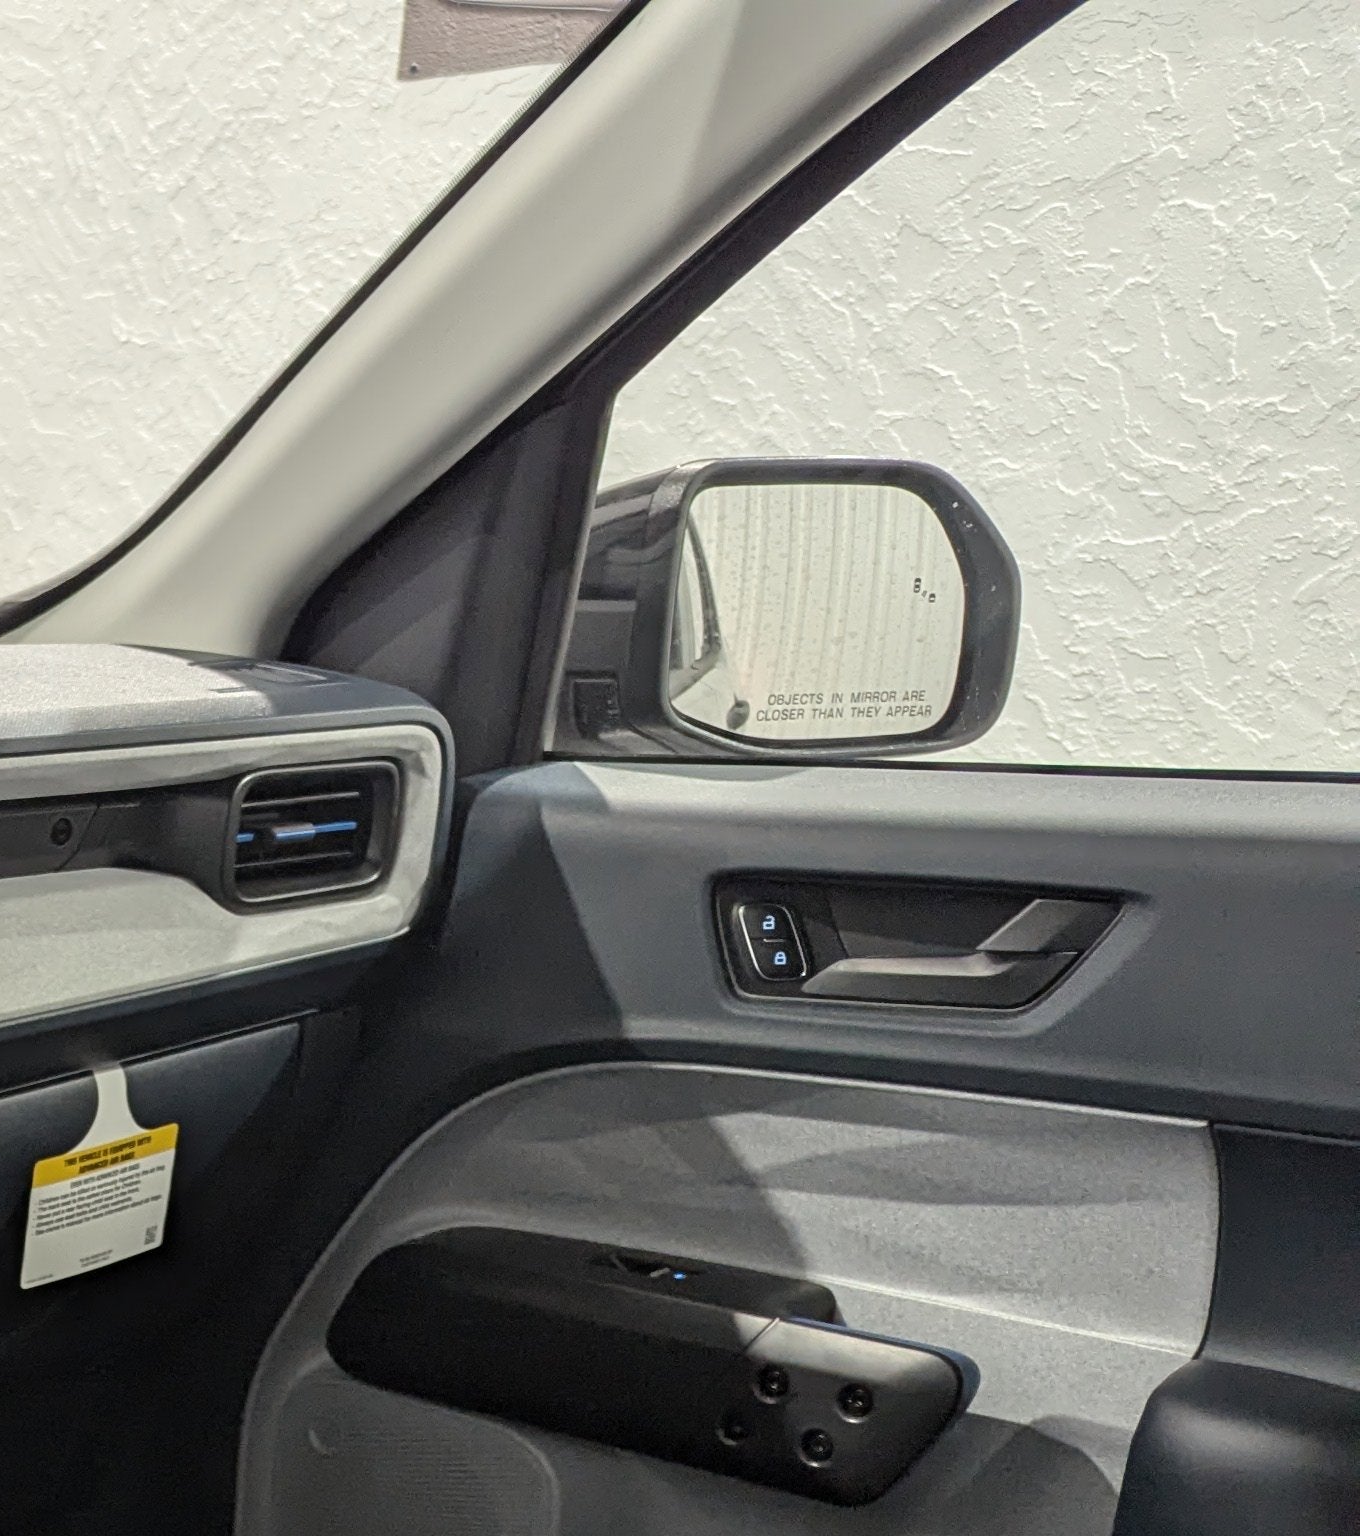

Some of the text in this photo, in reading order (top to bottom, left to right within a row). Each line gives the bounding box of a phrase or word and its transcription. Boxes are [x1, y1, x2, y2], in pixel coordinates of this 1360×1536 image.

[768, 690, 926, 706] OBJECTS IN MIRROR ARE
[756, 705, 932, 721] CLOSER THAN THEY APPEAR
